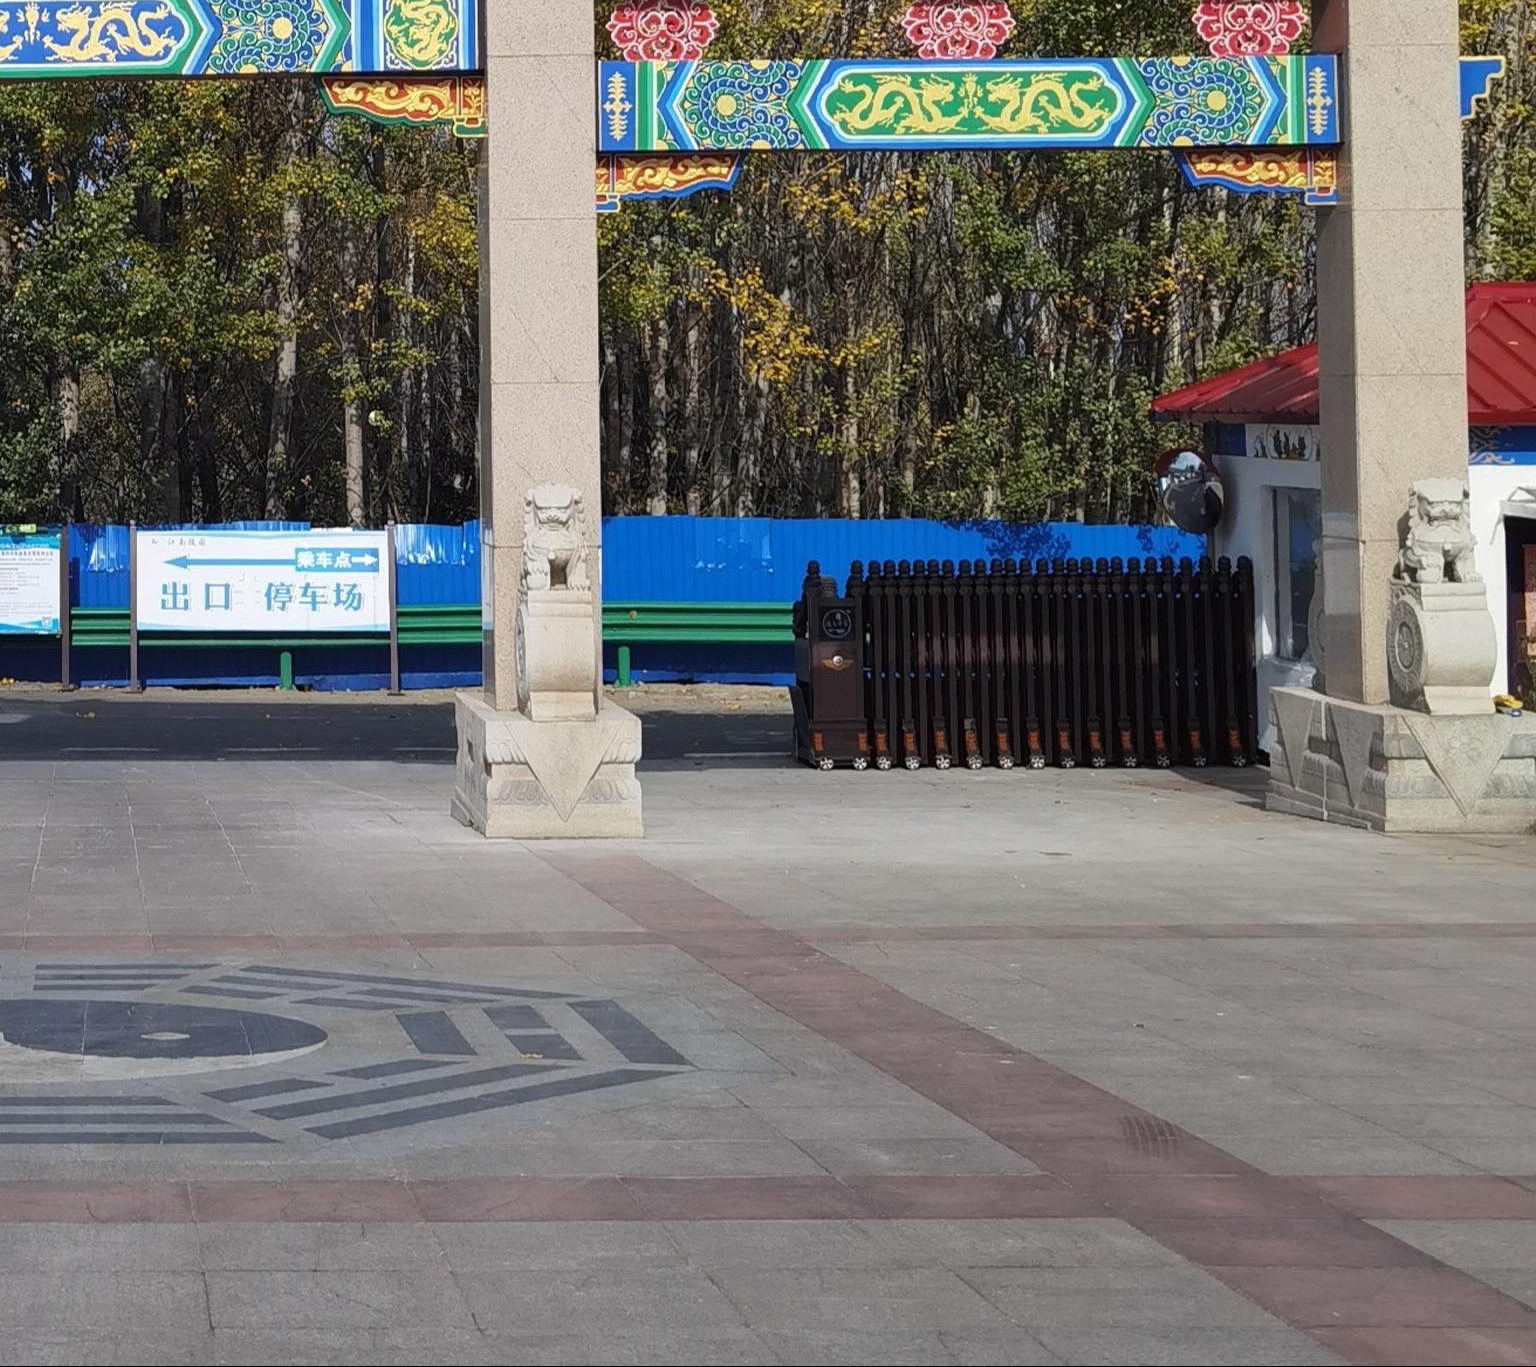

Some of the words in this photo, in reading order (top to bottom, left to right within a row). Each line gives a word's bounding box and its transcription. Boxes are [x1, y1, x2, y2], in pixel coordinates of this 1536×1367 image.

[296, 550, 352, 569] 乘车点
[160, 582, 232, 612] 出口
[264, 582, 363, 613] 停车场
